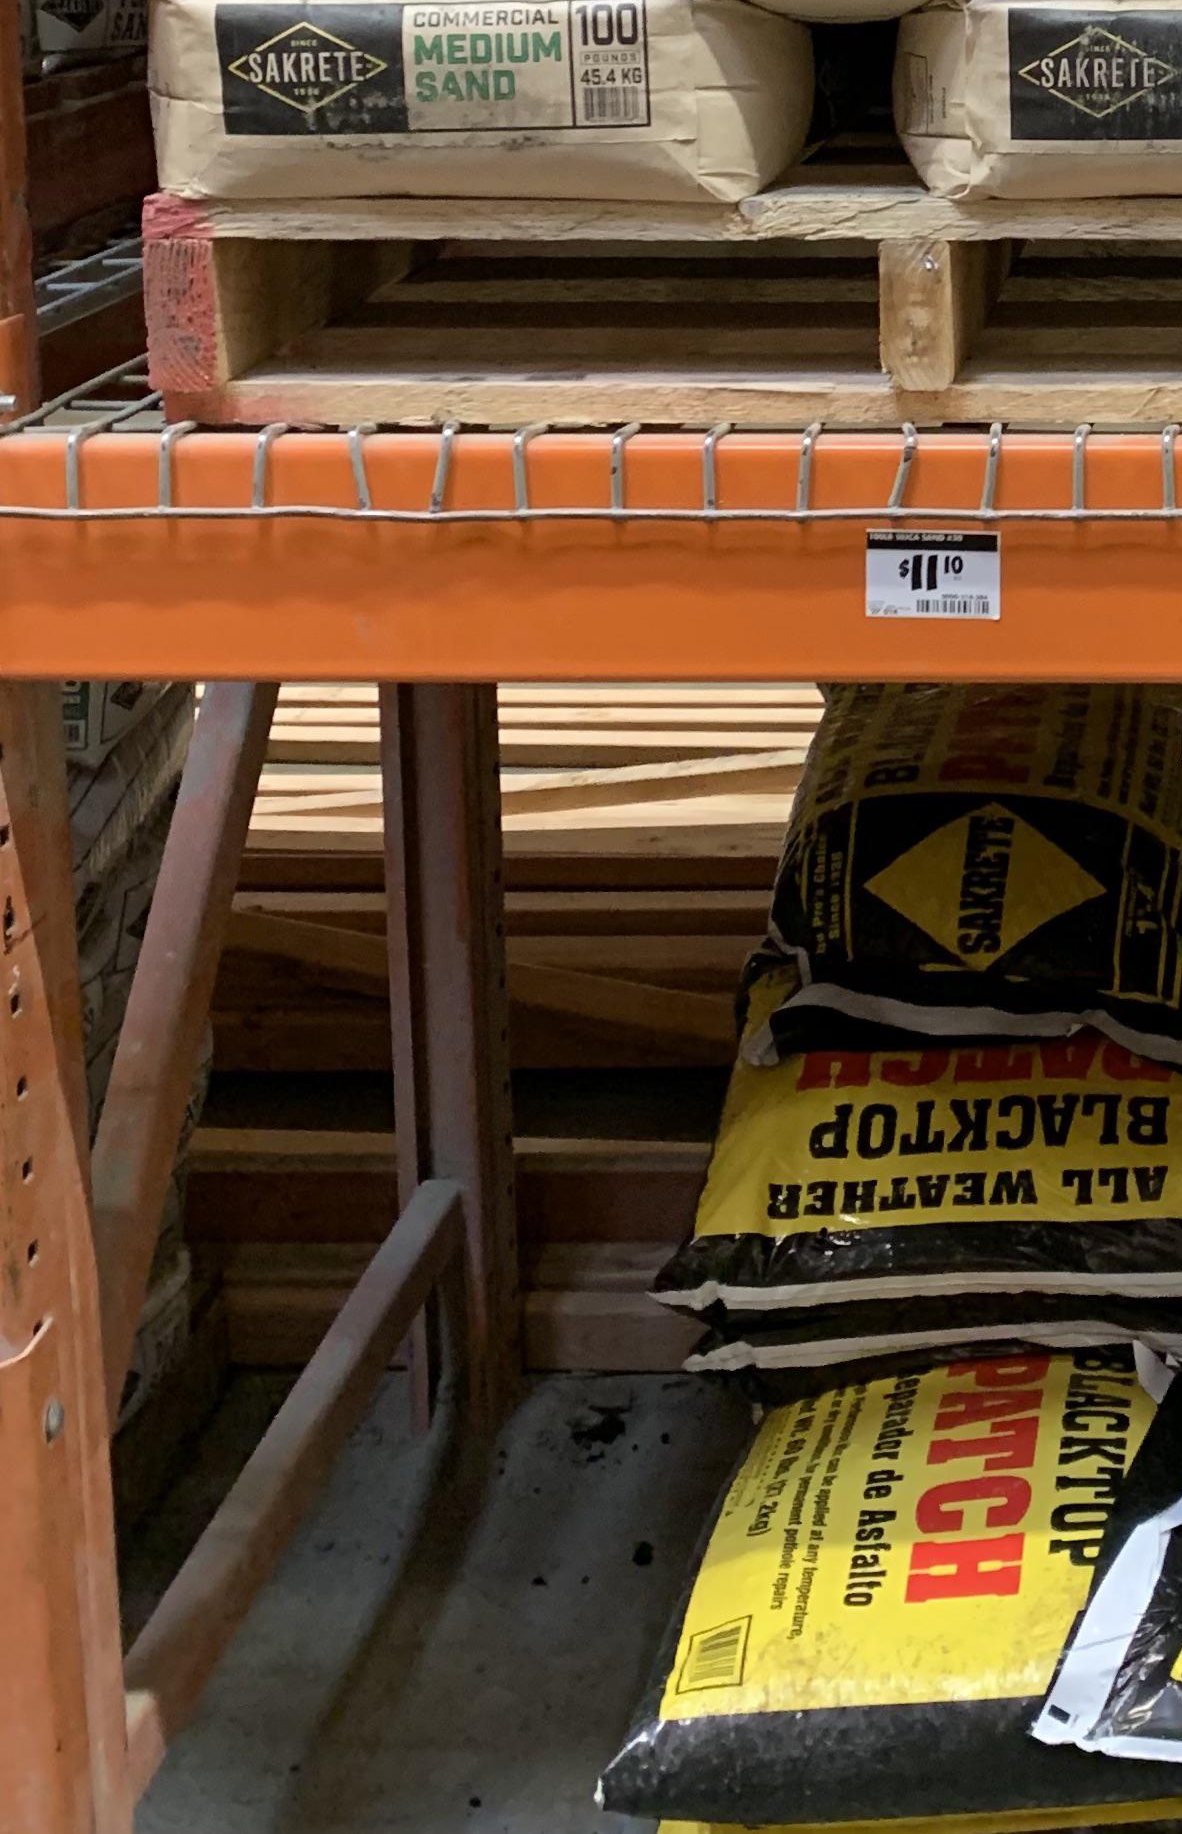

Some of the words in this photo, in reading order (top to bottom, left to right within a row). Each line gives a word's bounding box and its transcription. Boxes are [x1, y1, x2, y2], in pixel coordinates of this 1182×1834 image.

[413, 9, 560, 28] COMMERCIAL
[576, 3, 638, 47] 100
[247, 51, 365, 84] SAKRETE
[413, 31, 562, 66] MEDIUM
[583, 53, 638, 63] POUNDS
[415, 70, 516, 103] SAND
[580, 68, 616, 85] 45.4
[621, 67, 642, 84] KG
[1040, 57, 1155, 89] SAKRETE
[957, 815, 1016, 954] SAKRETE
[808, 1093, 1171, 1161] BLACKTOP
[766, 1168, 1039, 1222] WEATHER
[1061, 1164, 1170, 1205] ALL
[904, 1353, 1051, 1605] PATCH
[1048, 1353, 1136, 1568] BLACKTOP
[863, 1469, 904, 1500] de
[809, 1489, 833, 1526] applied
[779, 1529, 801, 1569] pothole
[803, 1544, 820, 1563] any
[843, 1510, 897, 1607] Asfalto
[770, 1572, 791, 1610] repairs
[788, 1567, 819, 1640] temperature,
